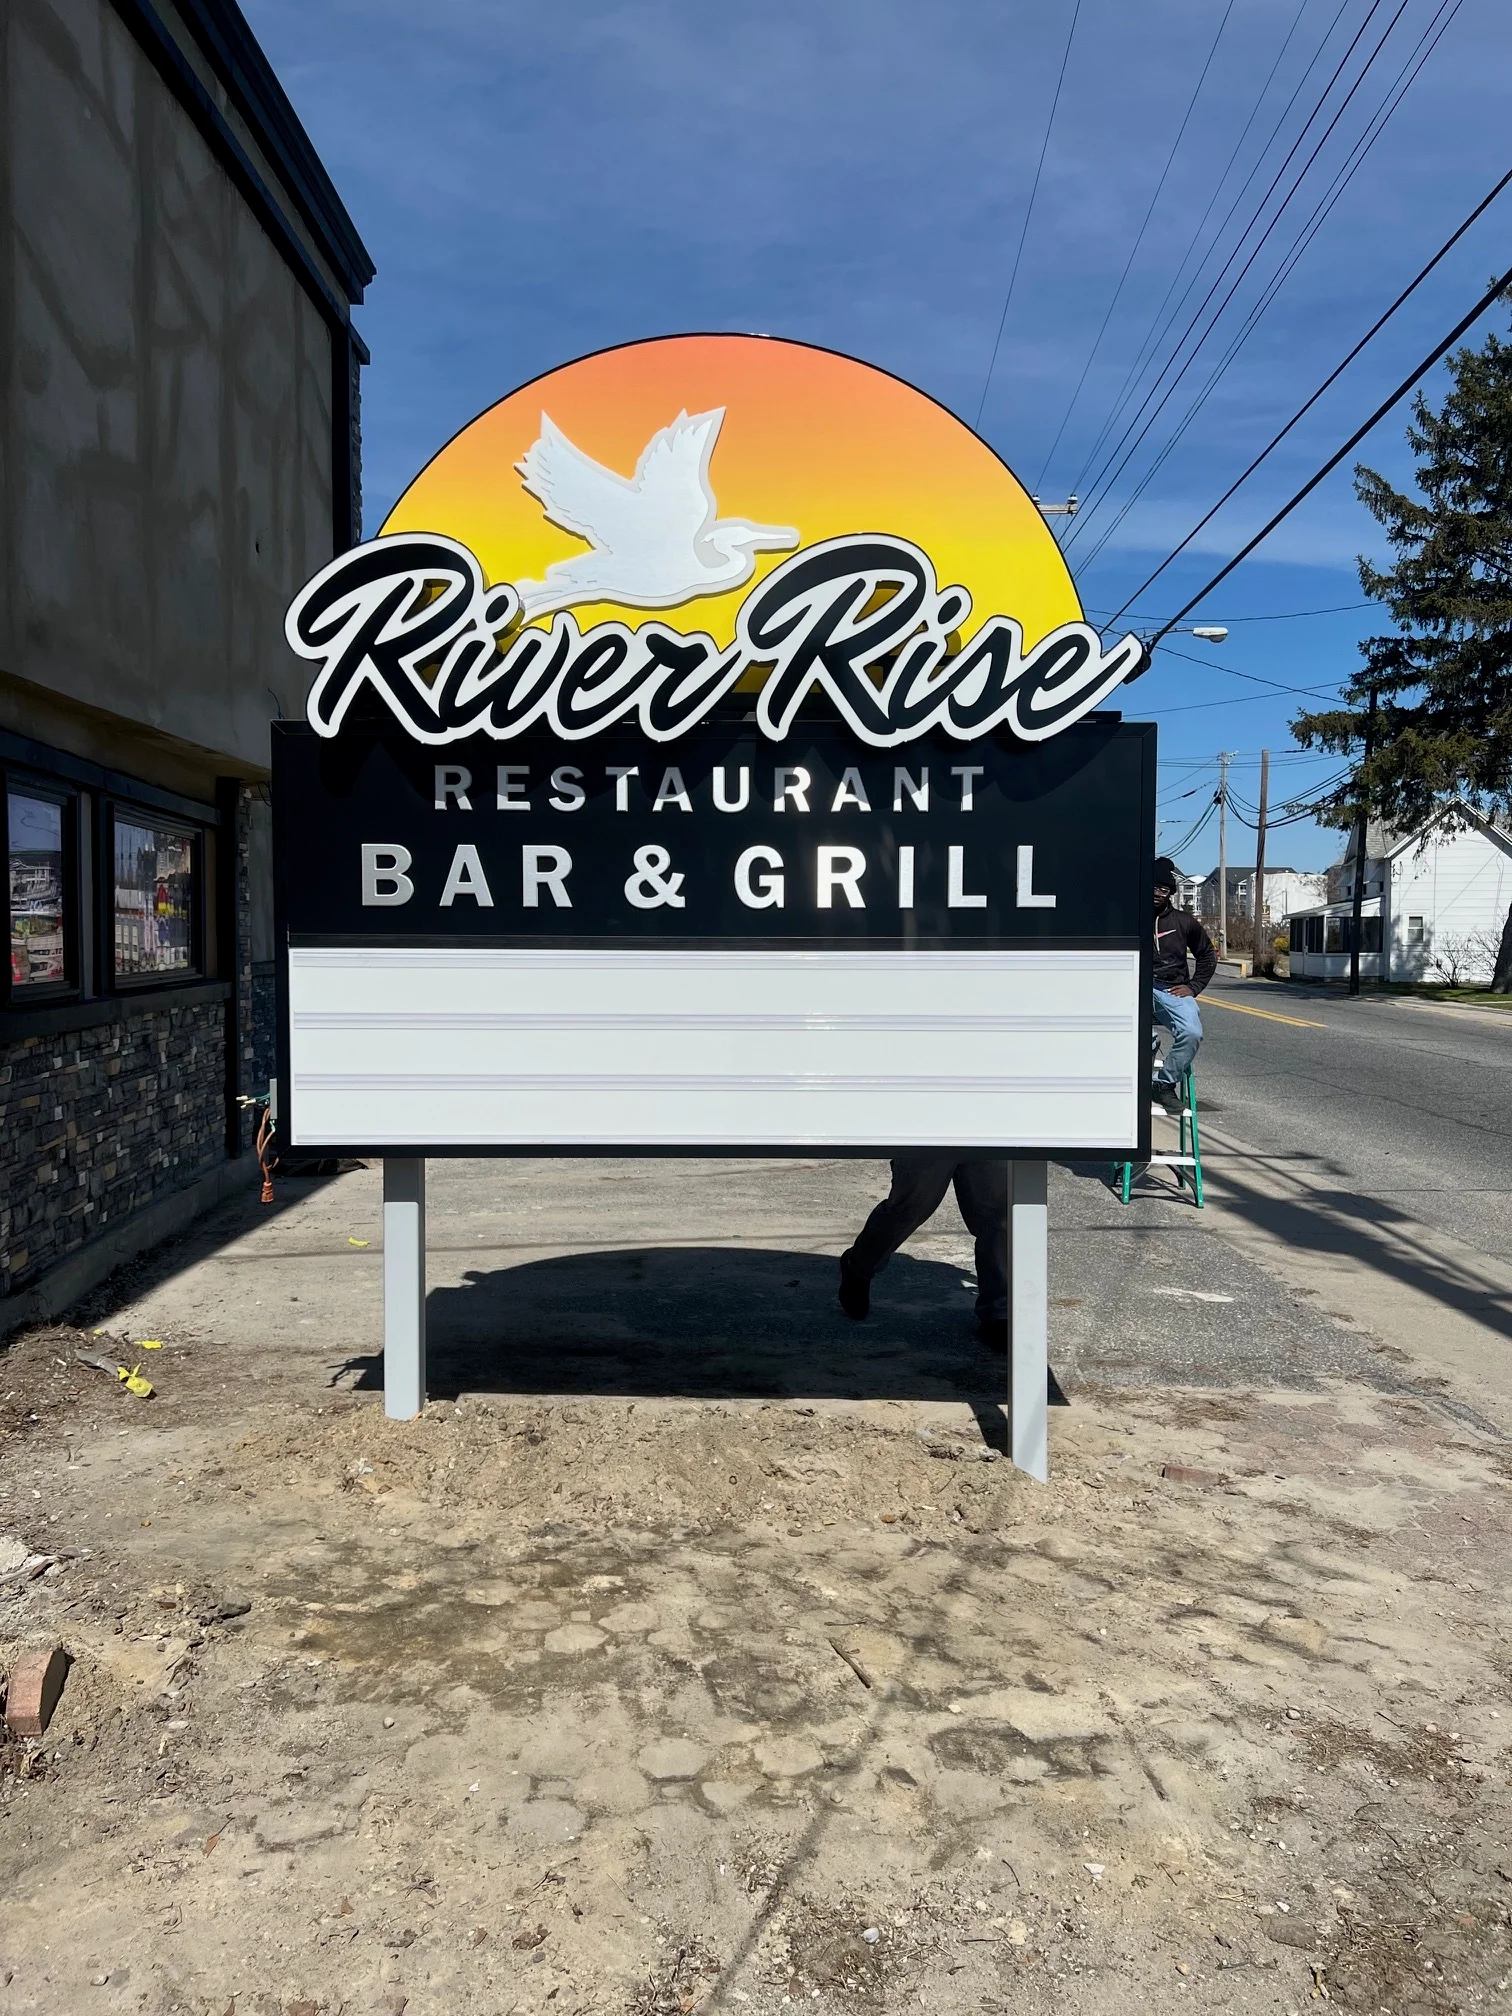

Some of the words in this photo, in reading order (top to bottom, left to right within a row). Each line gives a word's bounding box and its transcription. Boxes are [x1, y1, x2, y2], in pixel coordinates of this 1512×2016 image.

[285, 534, 747, 746] River
[738, 534, 1142, 748] Rise
[434, 766, 985, 813] RESTAURANT
[361, 844, 573, 908] BAR
[624, 845, 686, 909] &
[734, 845, 1057, 909] GRILL
